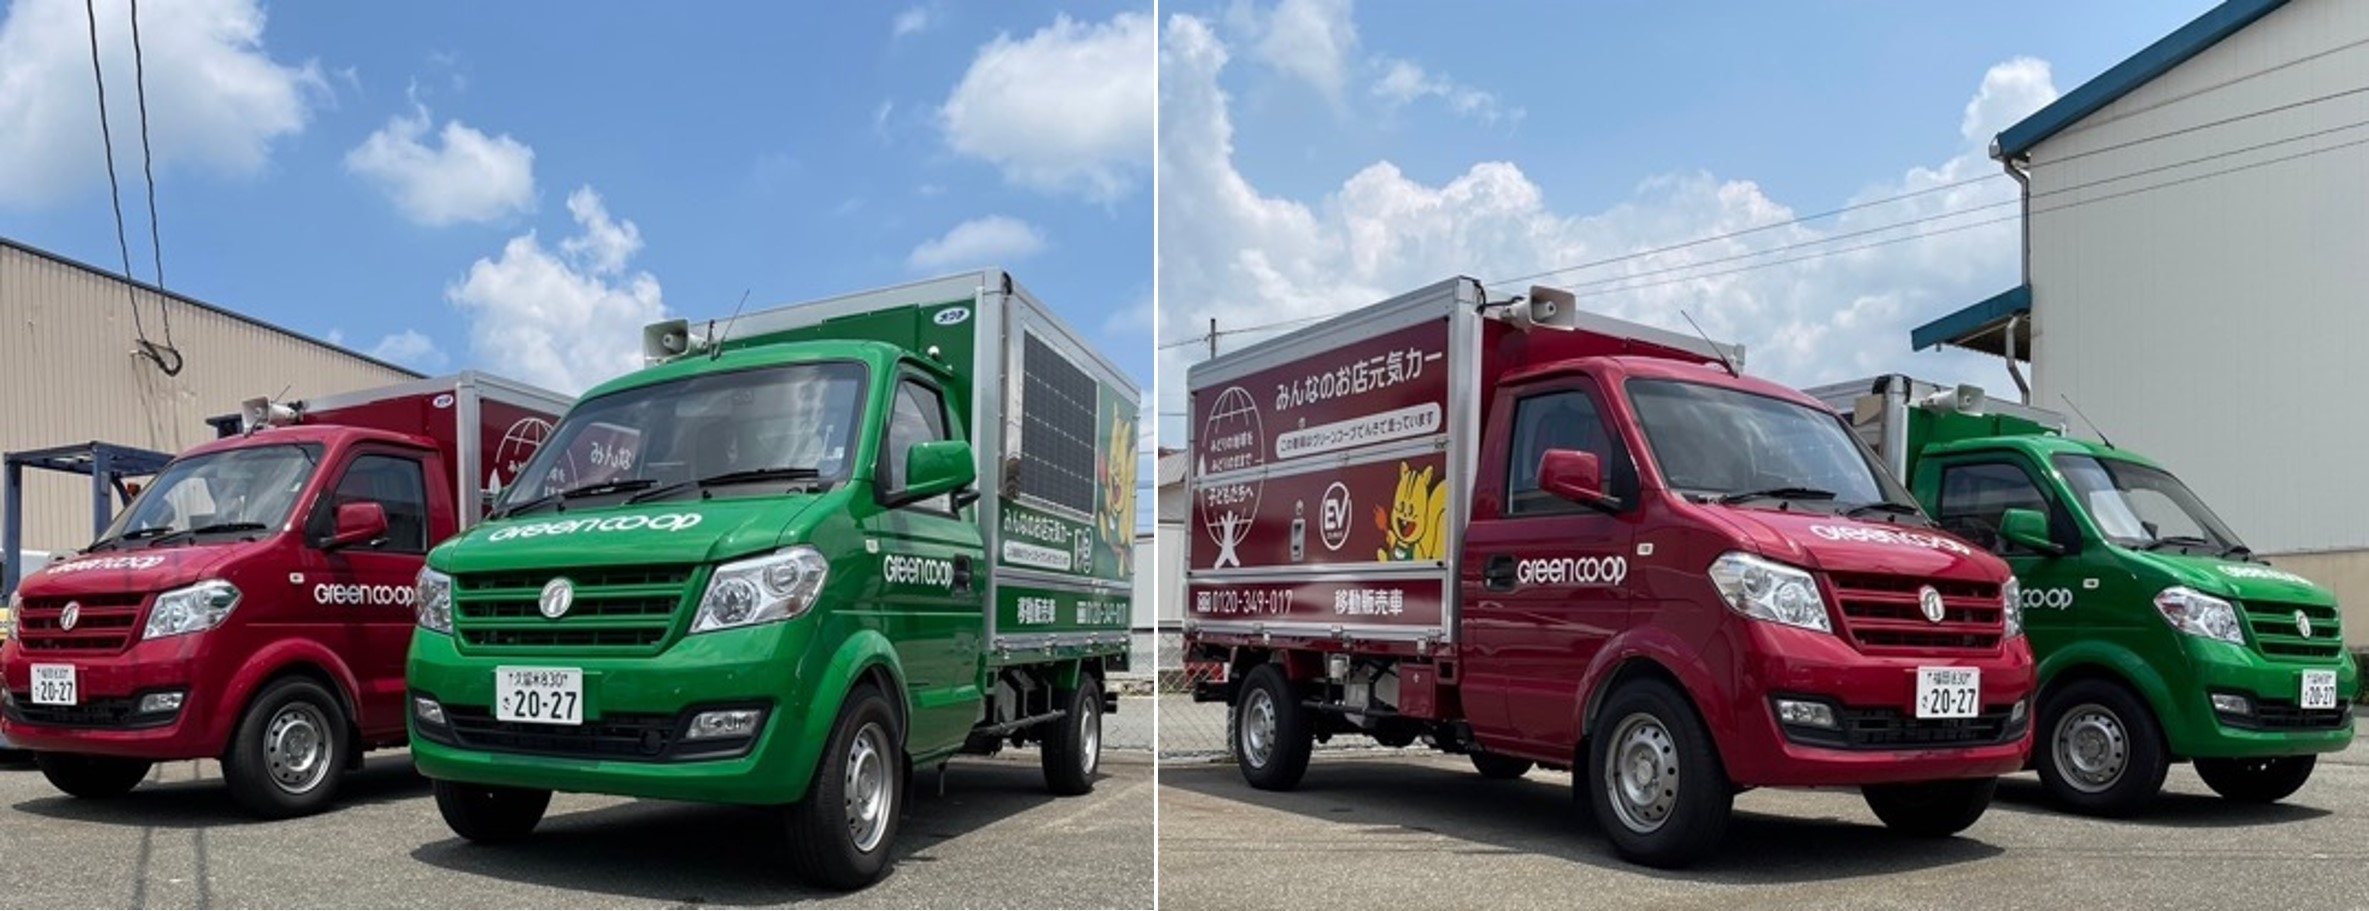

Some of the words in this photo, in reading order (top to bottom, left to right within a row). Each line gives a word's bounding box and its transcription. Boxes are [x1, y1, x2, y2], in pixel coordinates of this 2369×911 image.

[1276, 347, 1443, 411] みんなのお店元気カー
[1325, 493, 1348, 529] EV
[1213, 589, 1293, 614] 0120-349-017
[1335, 589, 1403, 615] 移動販売車
[41, 680, 73, 702] 20-27
[514, 689, 577, 720] 20-27
[1931, 688, 1976, 714] 20-27
